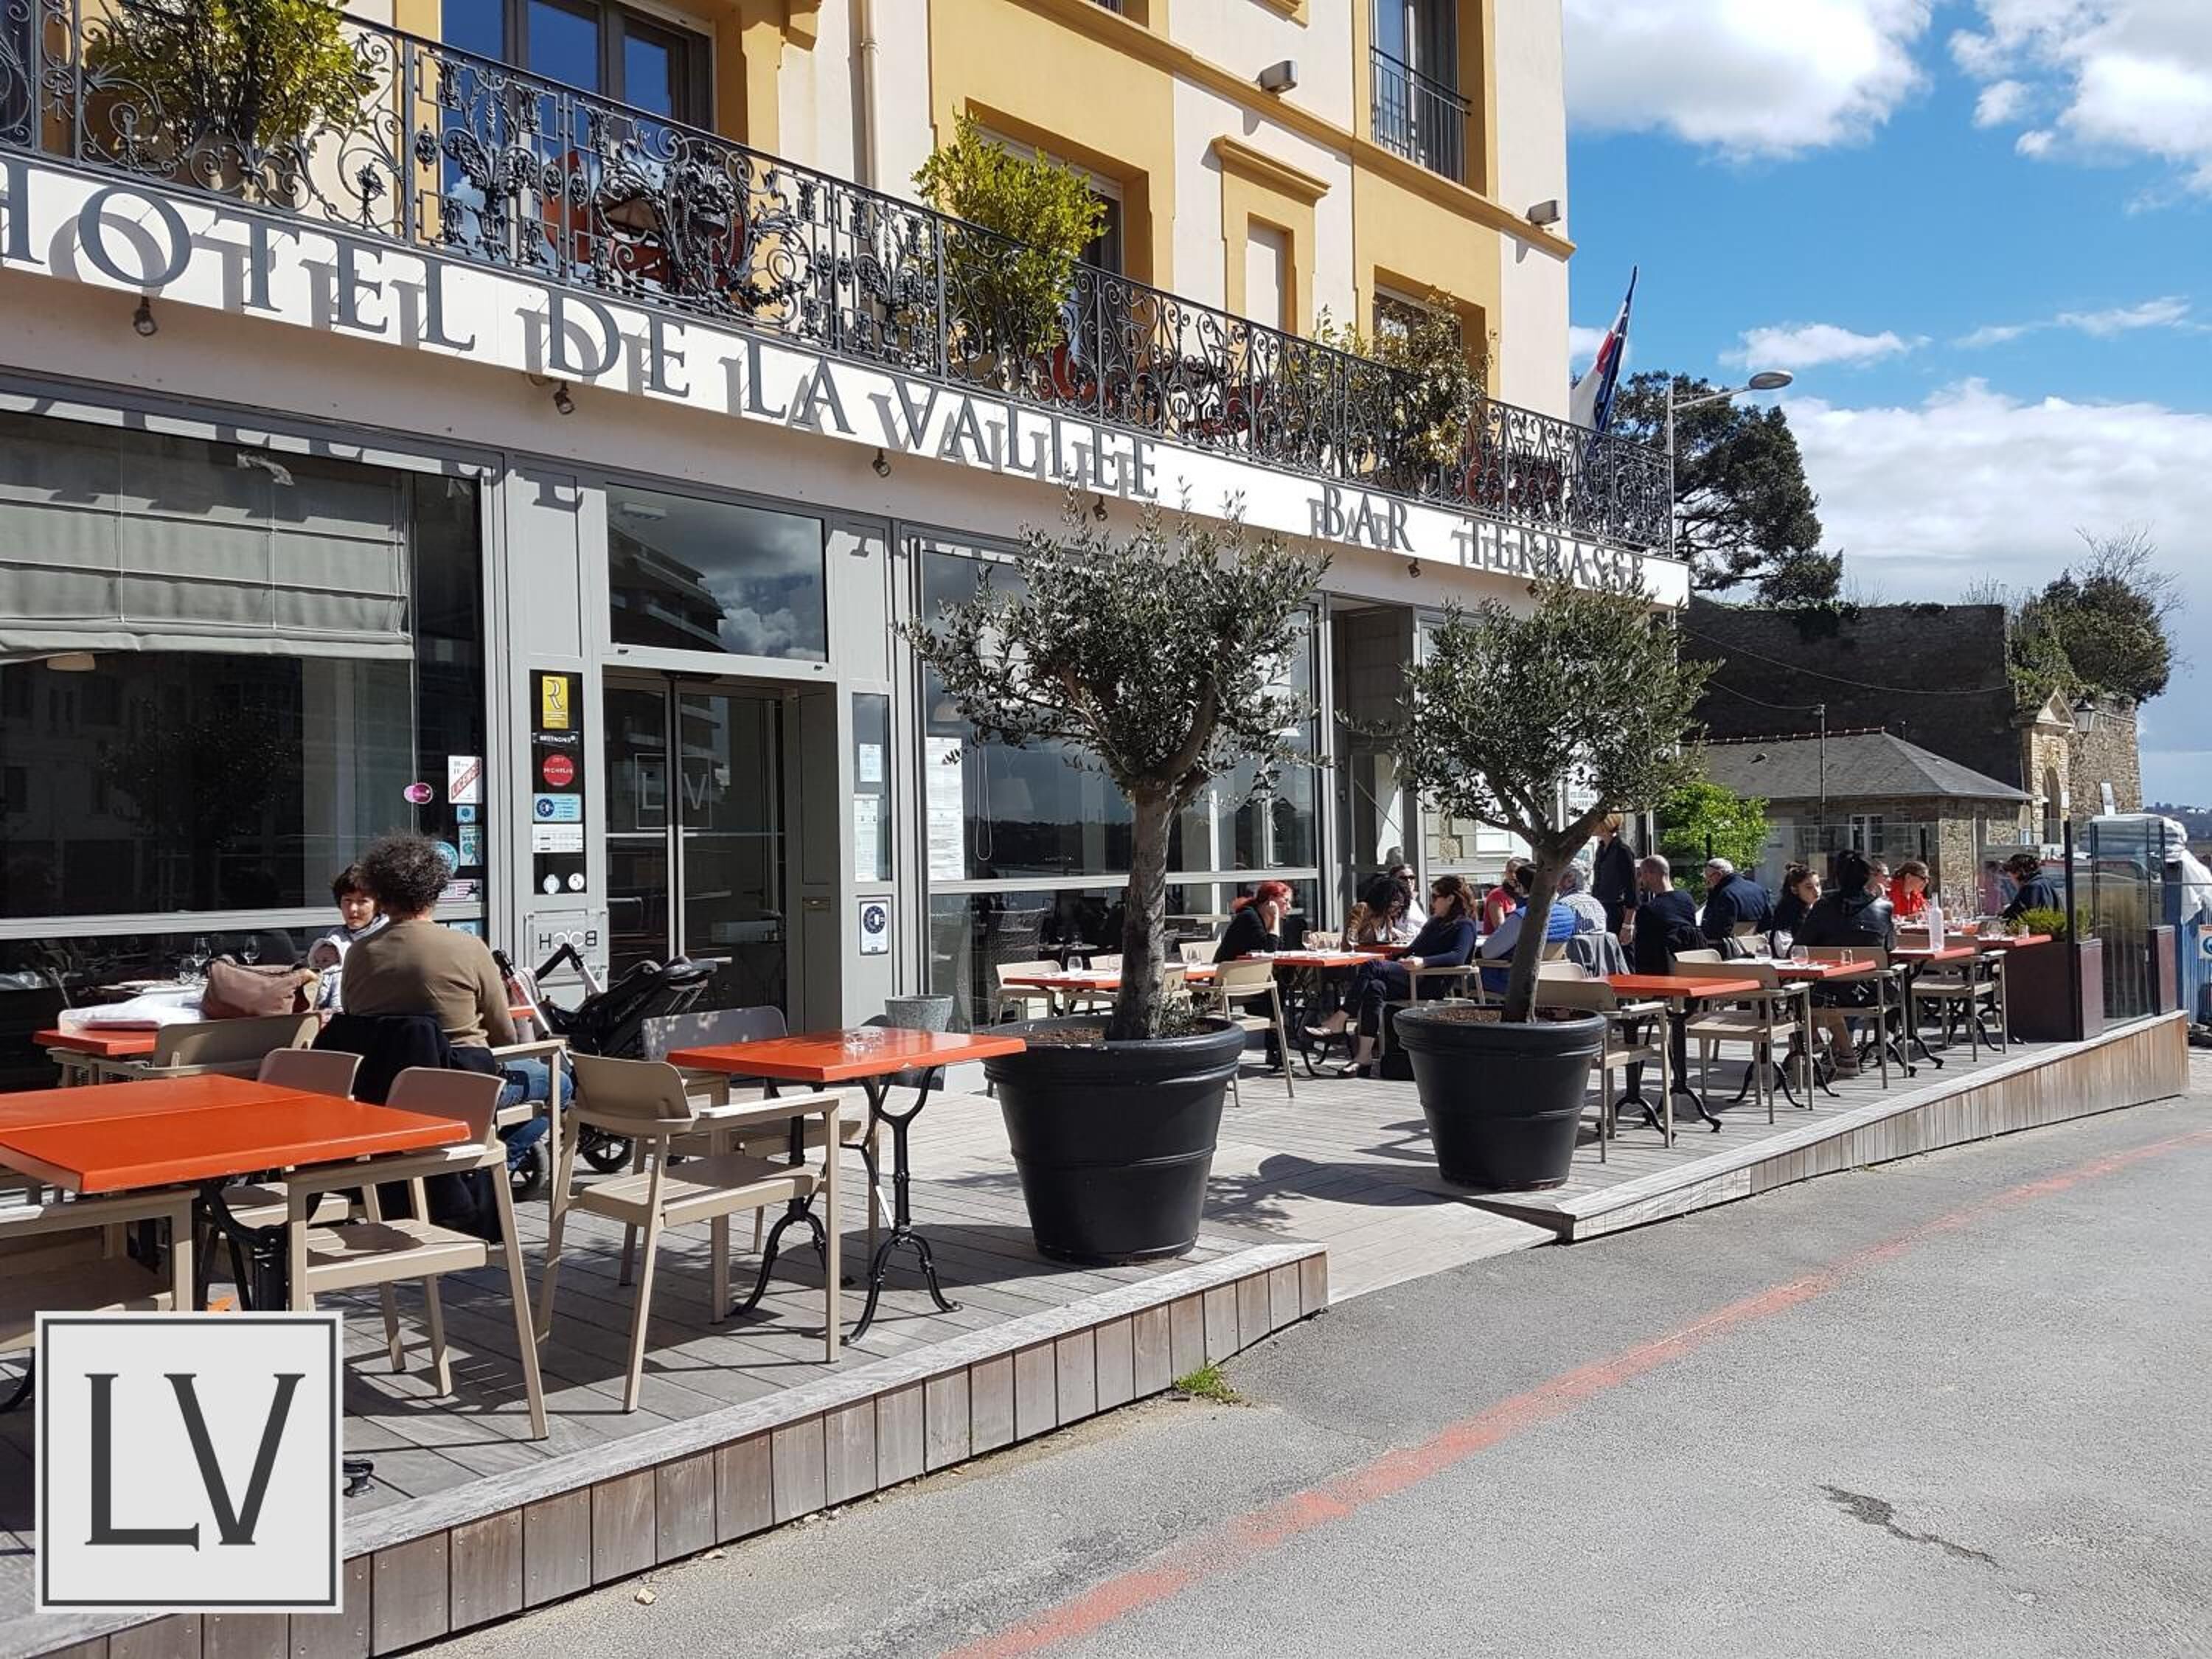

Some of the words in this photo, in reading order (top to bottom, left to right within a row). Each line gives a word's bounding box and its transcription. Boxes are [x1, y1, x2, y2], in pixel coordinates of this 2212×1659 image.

[548, 288, 689, 397] DE
[743, 336, 856, 434] LA
[891, 376, 1157, 498] VALLEE
[1323, 484, 1414, 552] BAR
[1464, 517, 1644, 592] TERRASSE
